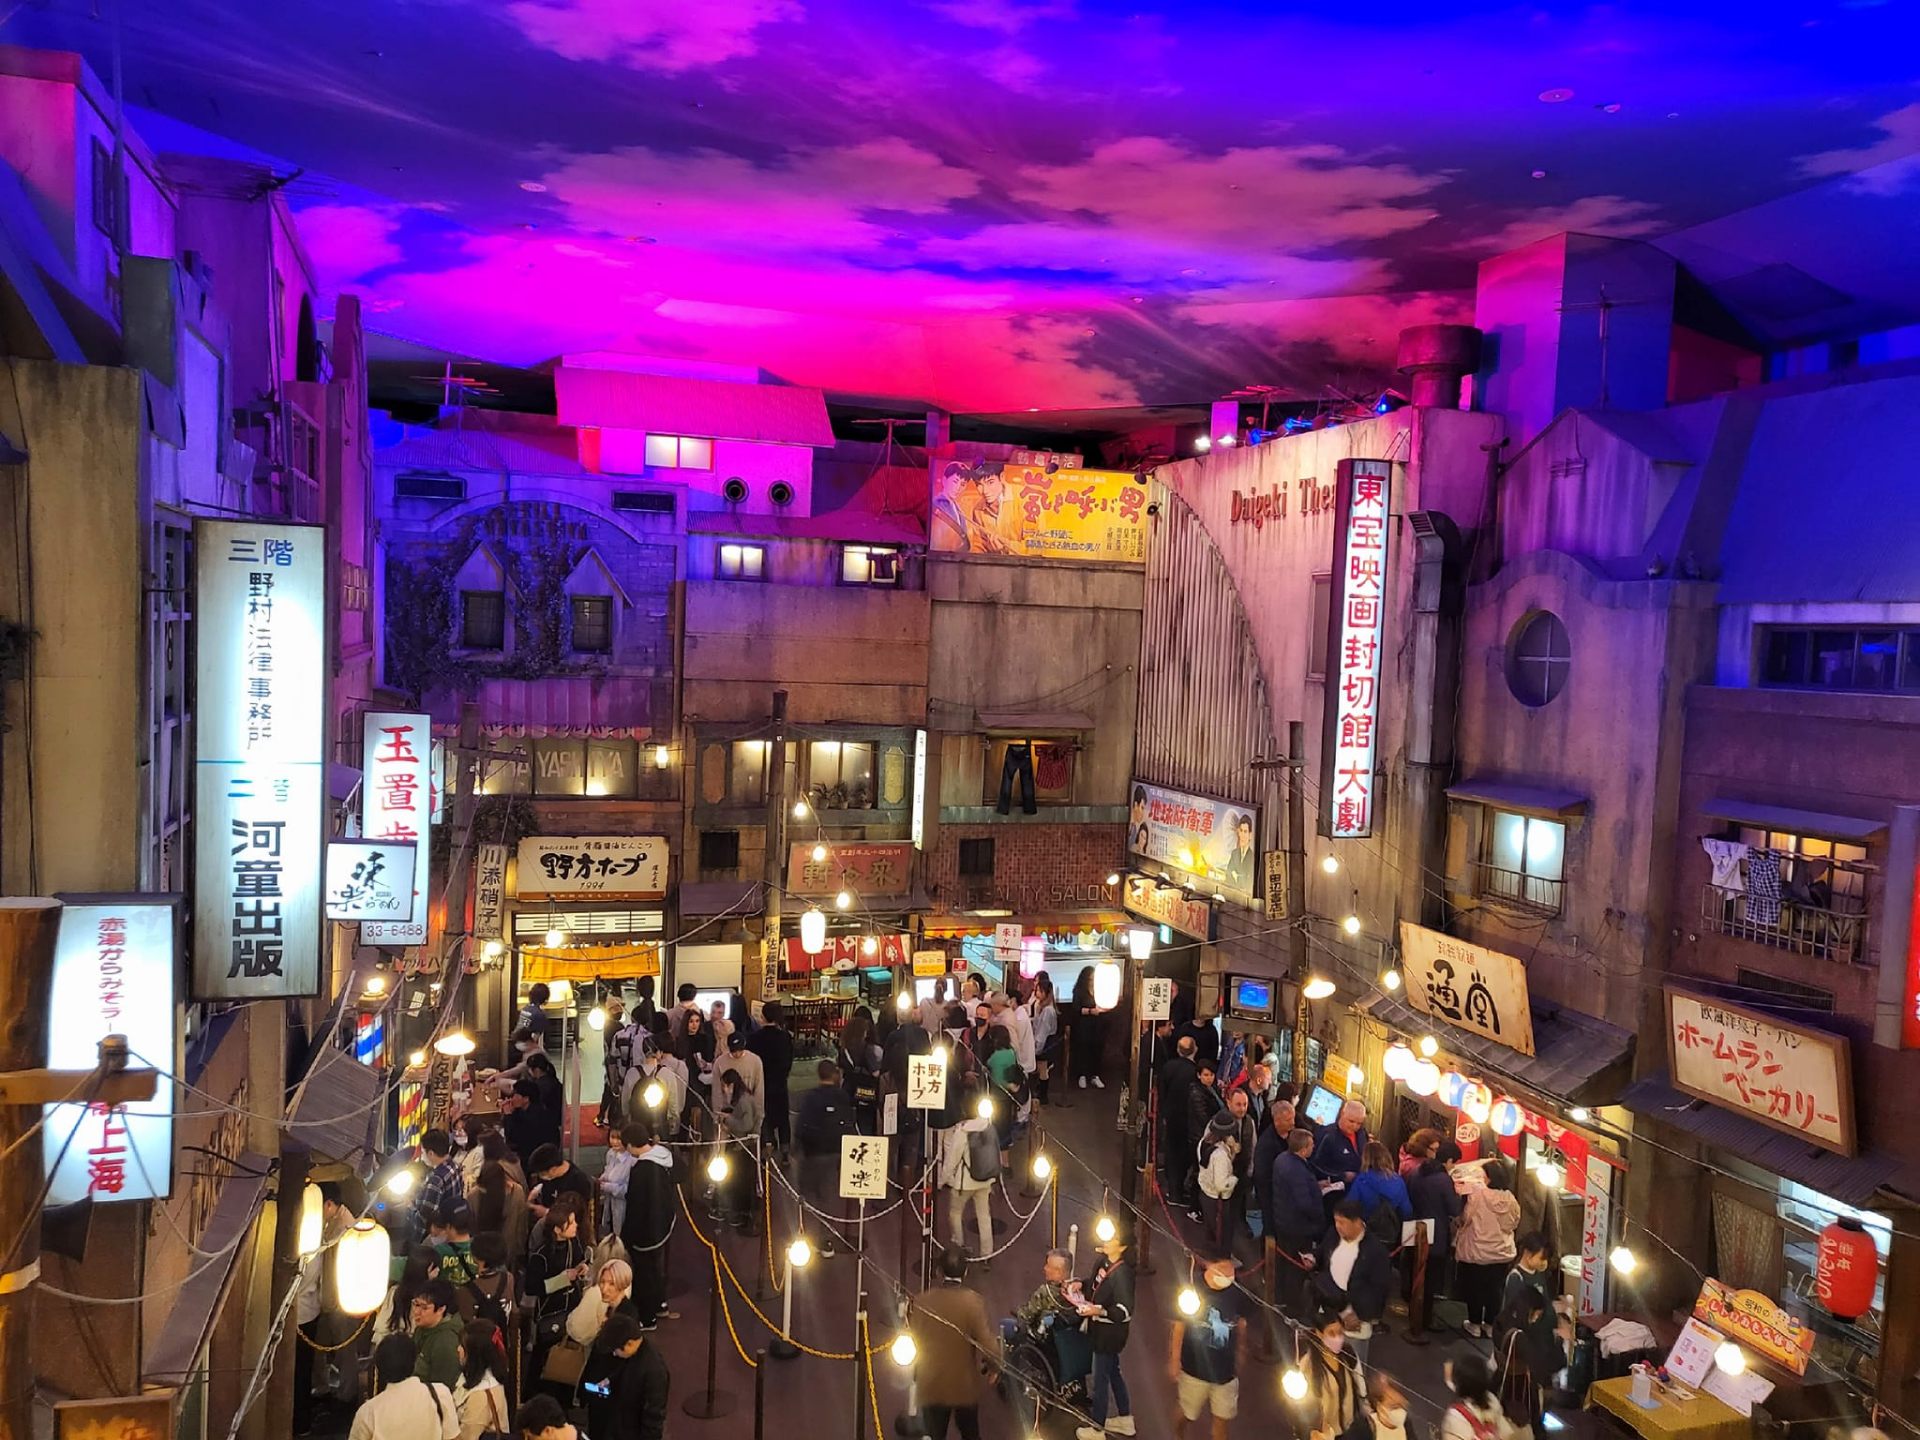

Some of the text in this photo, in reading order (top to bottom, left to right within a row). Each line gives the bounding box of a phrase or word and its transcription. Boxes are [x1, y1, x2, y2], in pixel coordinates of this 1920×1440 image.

[1230, 481, 1288, 529] Daigeki
[228, 538, 295, 567] 三階
[247, 571, 275, 750] 野村法律事務所
[1336, 472, 1386, 833] 東宝映画封切館 大劇
[1148, 798, 1216, 837] 地球防衛軍
[326, 850, 390, 912] 味楽
[479, 850, 501, 924] 川添硝子
[540, 852, 648, 880] 野方ホープ
[227, 818, 286, 979] 河童出版
[1051, 884, 1113, 902] SALON
[367, 924, 423, 938] 33-6488
[97, 917, 127, 1032] 赤湯からみそラー
[1677, 1020, 1783, 1075] ホームラン
[912, 1062, 926, 1100] ホープ
[928, 1063, 942, 1093] 野方
[1722, 1072, 1838, 1129] ベーカリー
[849, 1142, 872, 1189] 味楽
[1581, 1194, 1599, 1315] オリオンビール
